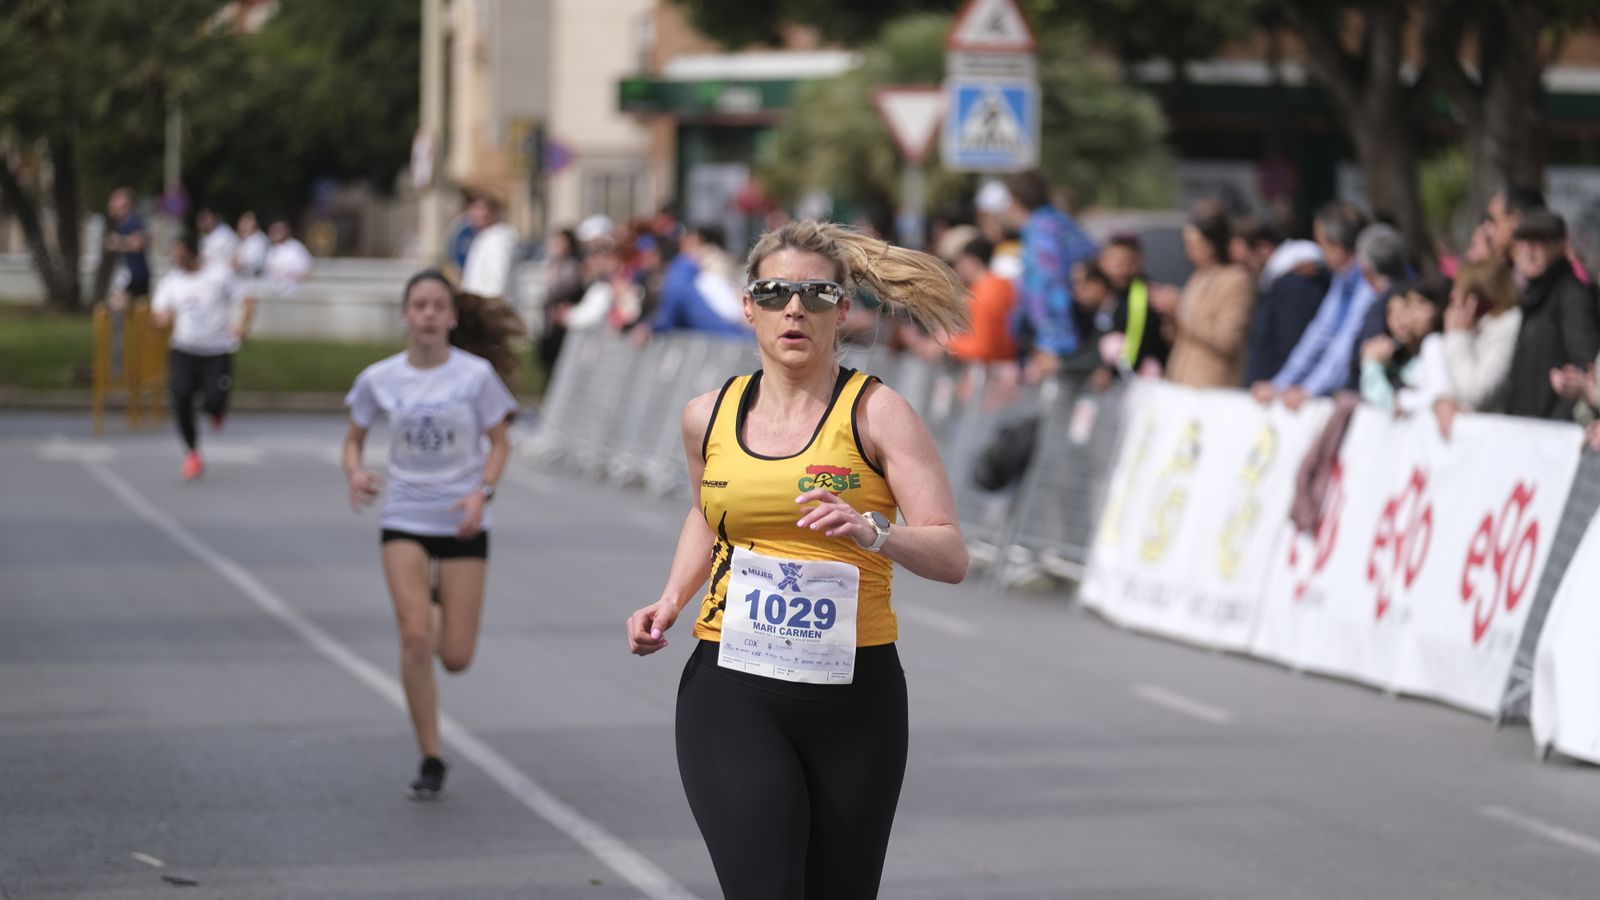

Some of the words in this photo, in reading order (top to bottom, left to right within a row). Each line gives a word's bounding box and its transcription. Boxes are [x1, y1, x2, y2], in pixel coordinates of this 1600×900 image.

[748, 567, 773, 580] MUJER
[1461, 477, 1539, 645] ego
[745, 589, 836, 630] 1029
[753, 622, 776, 634] MARI
[779, 627, 822, 639] CARMEN
